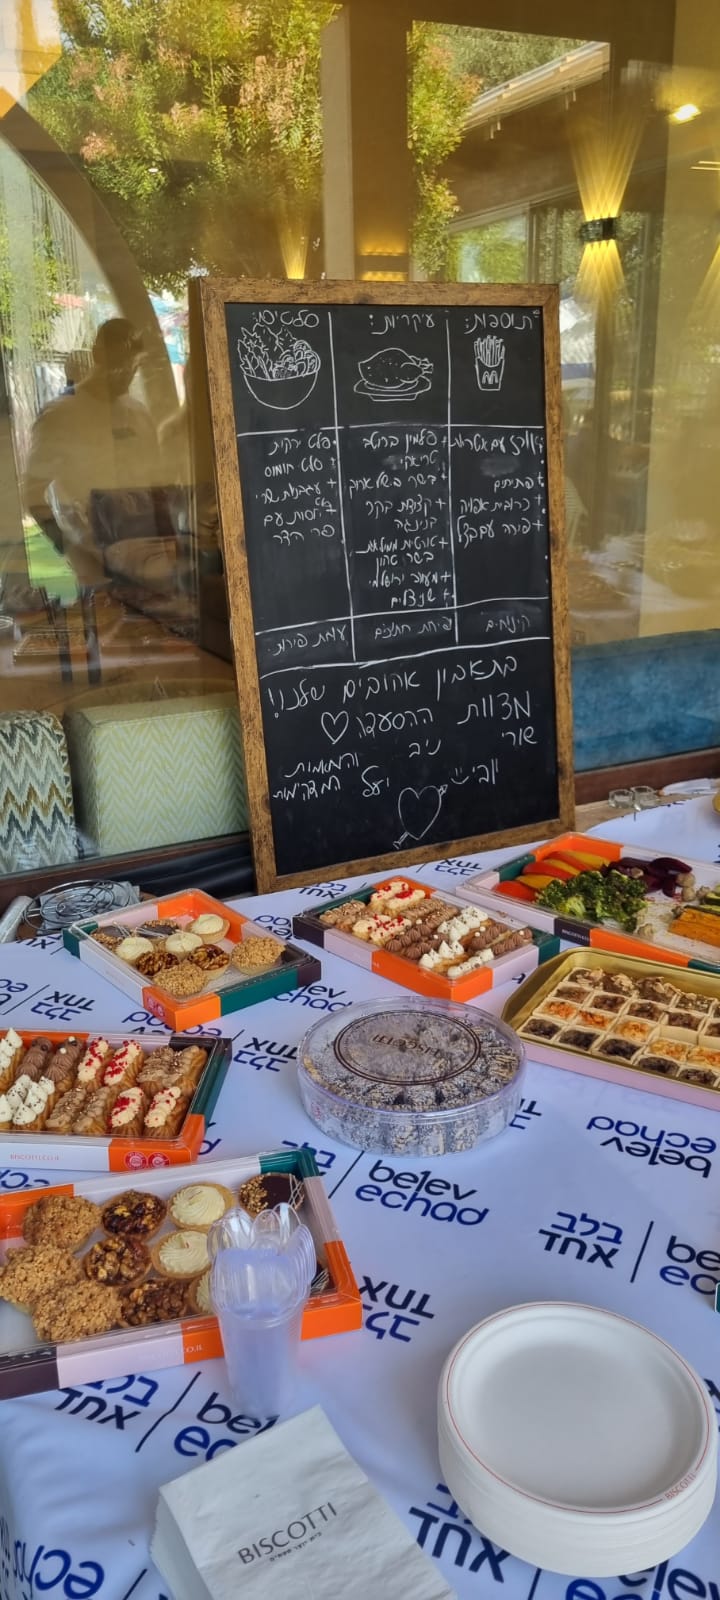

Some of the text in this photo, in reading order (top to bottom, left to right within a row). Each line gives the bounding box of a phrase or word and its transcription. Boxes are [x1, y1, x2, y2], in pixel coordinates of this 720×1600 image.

[464, 312, 533, 335] תוספות:
[263, 512, 284, 527] עם
[406, 551, 434, 564] בשר
[342, 671, 420, 704] אהובים
[408, 739, 442, 759] ניב
[43, 991, 95, 1011] אחד
[300, 983, 346, 998] lev
[30, 1001, 82, 1021] בלב
[233, 1050, 288, 1072] בלב
[586, 1115, 717, 1154] echad
[600, 1136, 712, 1178] belev
[368, 1159, 478, 1200] belev
[355, 1183, 490, 1226] echad
[551, 1211, 623, 1245] בלב
[538, 1228, 620, 1269] אחד
[358, 1275, 435, 1319] אחד
[362, 1304, 420, 1342] לב
[54, 1387, 141, 1430] אחד
[665, 1473, 697, 1500] BISCOTTI
[238, 1502, 337, 1565] BISCOTTI
[408, 1507, 511, 1583] אחד
